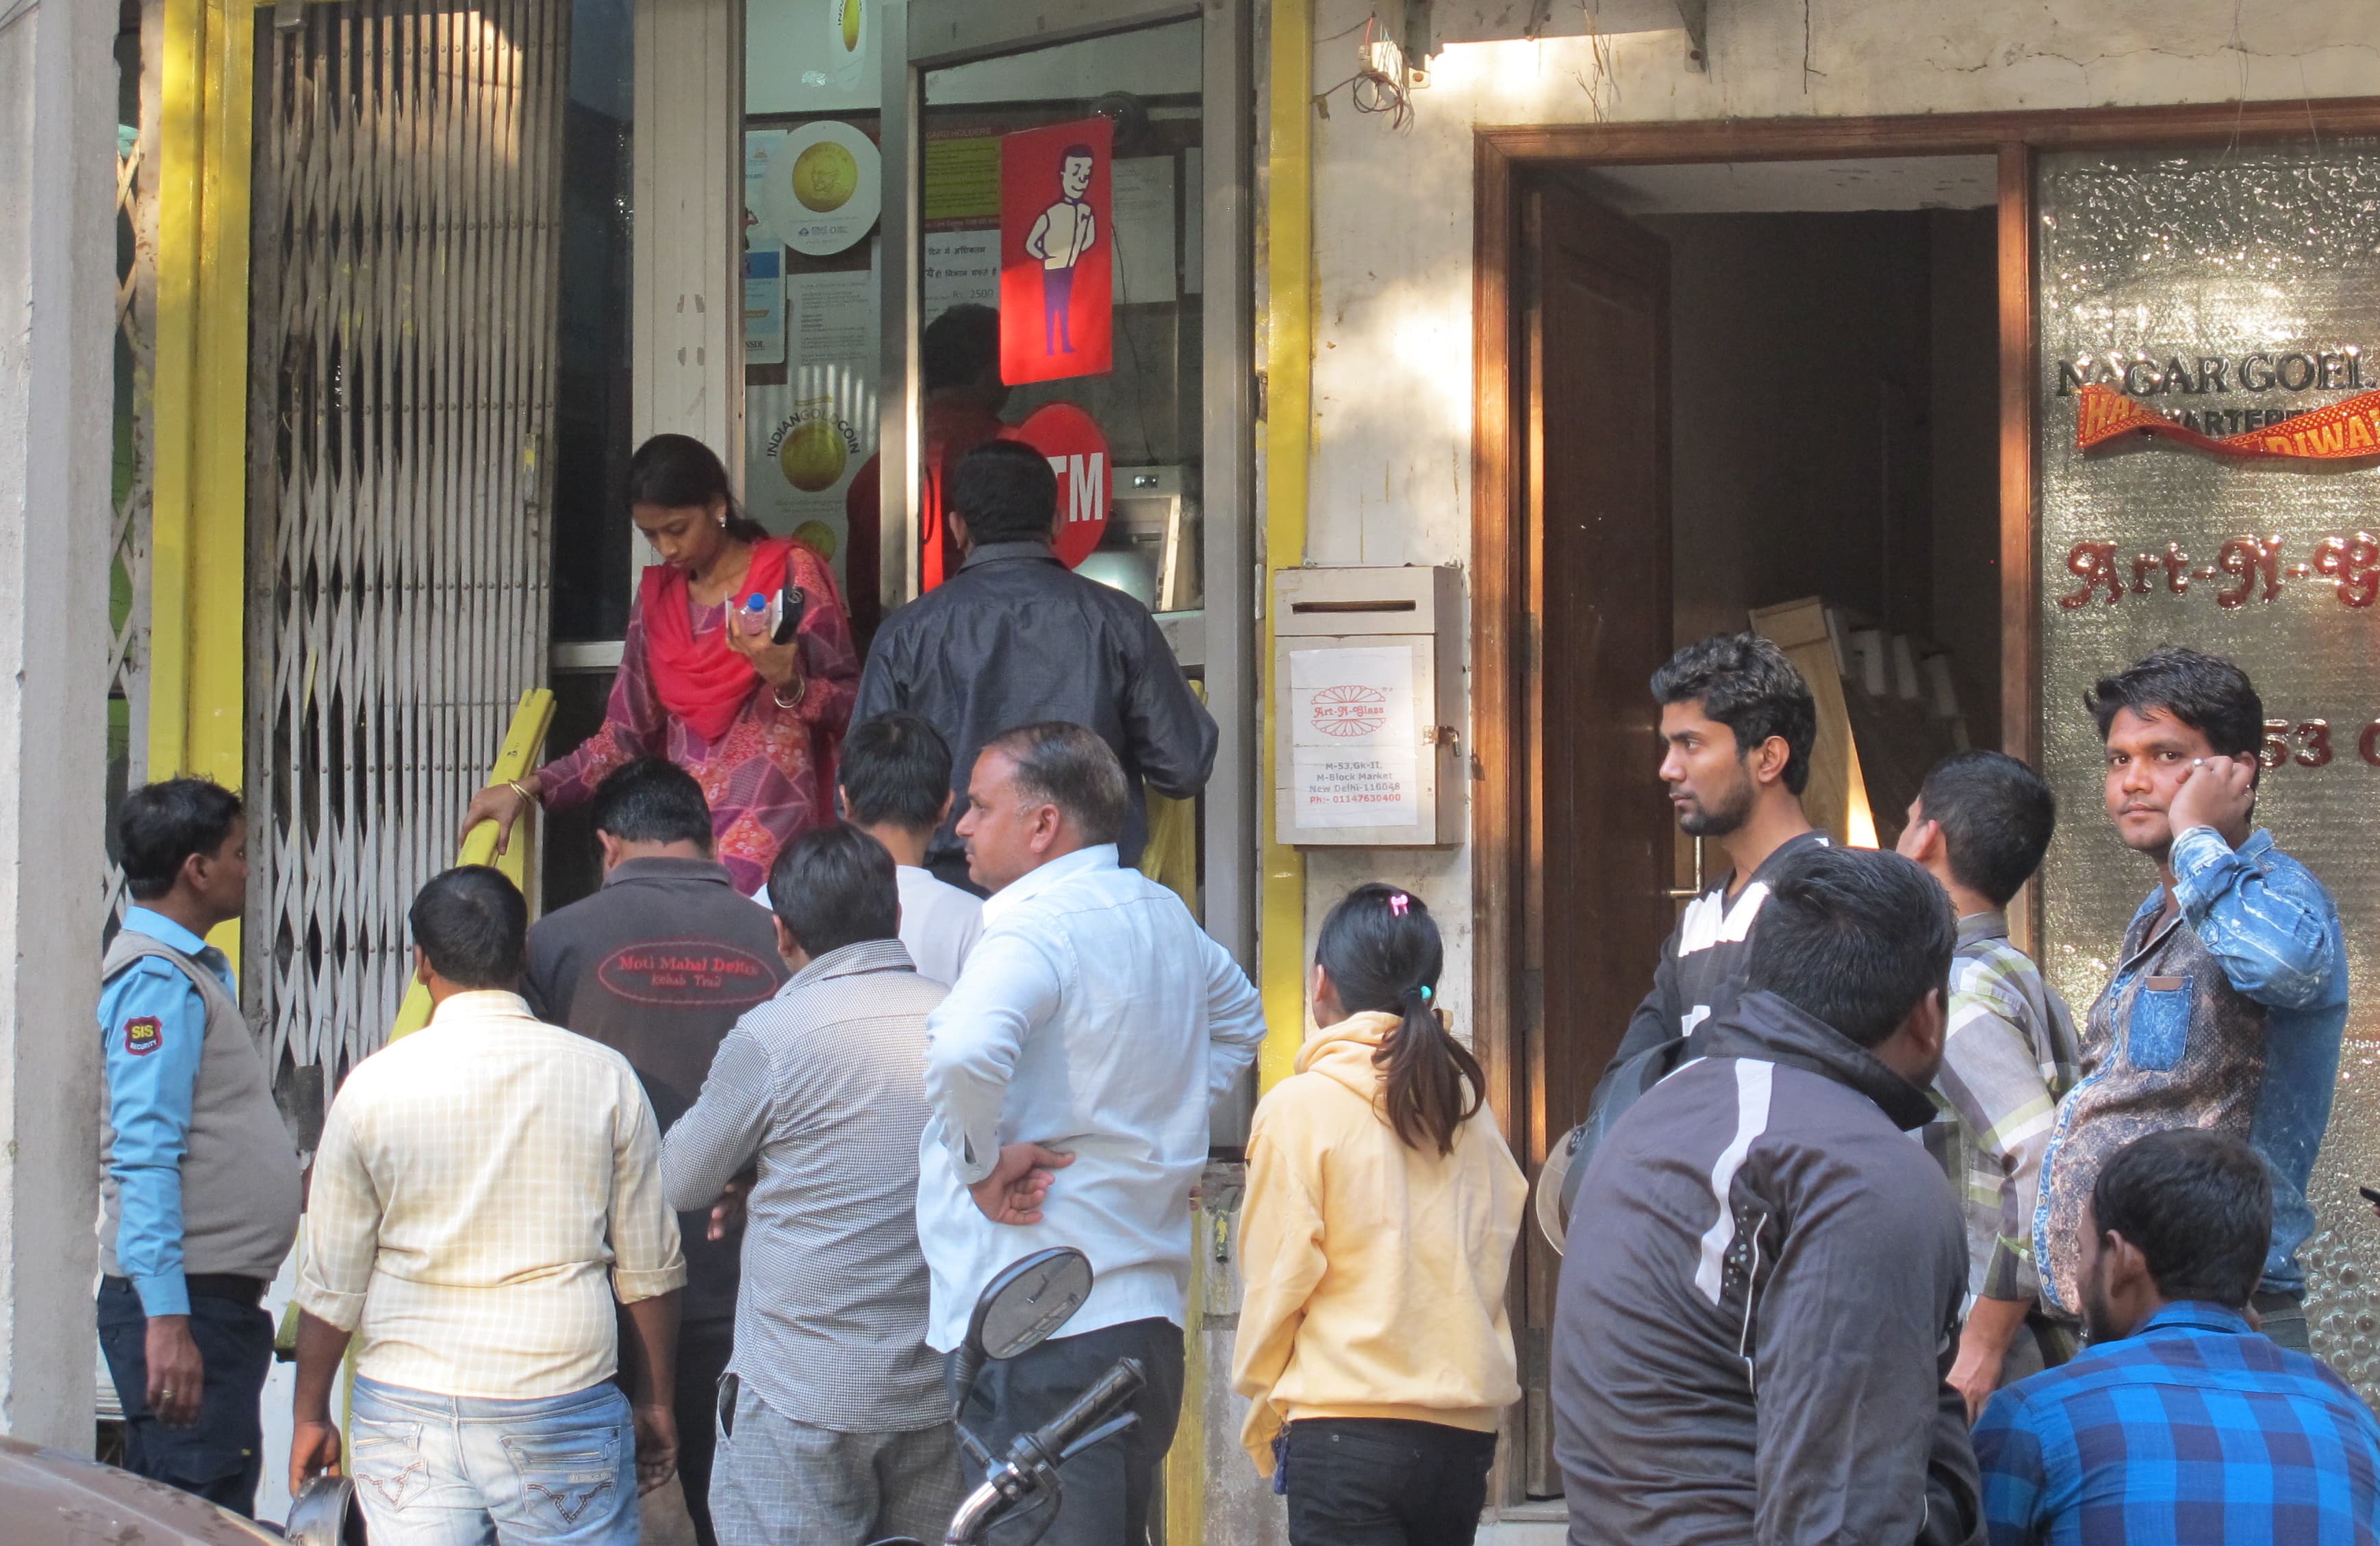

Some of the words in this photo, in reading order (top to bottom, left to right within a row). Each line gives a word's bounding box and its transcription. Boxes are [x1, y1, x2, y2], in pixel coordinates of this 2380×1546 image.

[970, 288, 994, 299] 2500
[2238, 351, 2378, 392] GOEL
[1313, 705, 1385, 718] Art-A-Glass
[1358, 772, 1393, 781] Market
[1309, 785, 1331, 794] New
[1334, 783, 1401, 793] Delhi-110048
[1332, 794, 1402, 804] 01147630400
[620, 956, 655, 971] Moti
[659, 957, 708, 972] Mahal
[651, 973, 687, 987] Kebab
[131, 1024, 154, 1039] SIS
[129, 1039, 157, 1050] SECURITY
